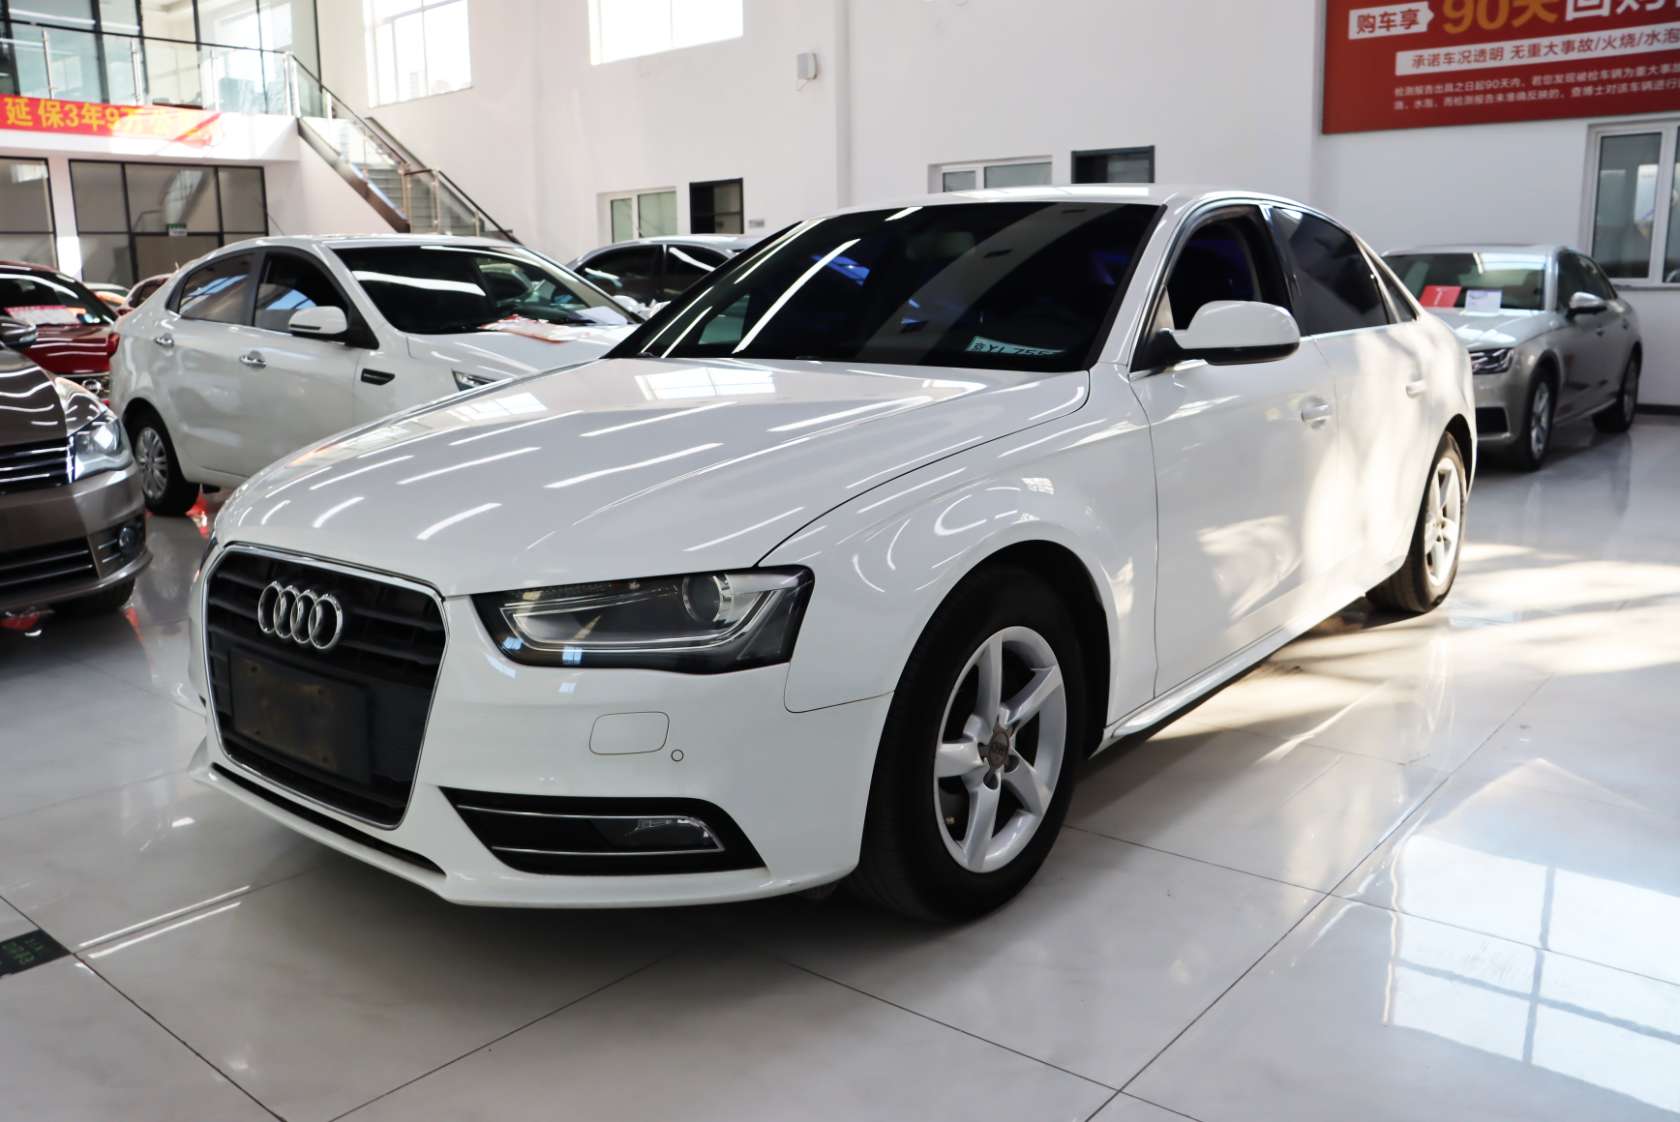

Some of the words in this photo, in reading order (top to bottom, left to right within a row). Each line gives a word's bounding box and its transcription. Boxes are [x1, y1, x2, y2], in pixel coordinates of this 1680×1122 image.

[1356, 8, 1421, 34] 购车享
[1412, 48, 1504, 69] 承诺车况透明
